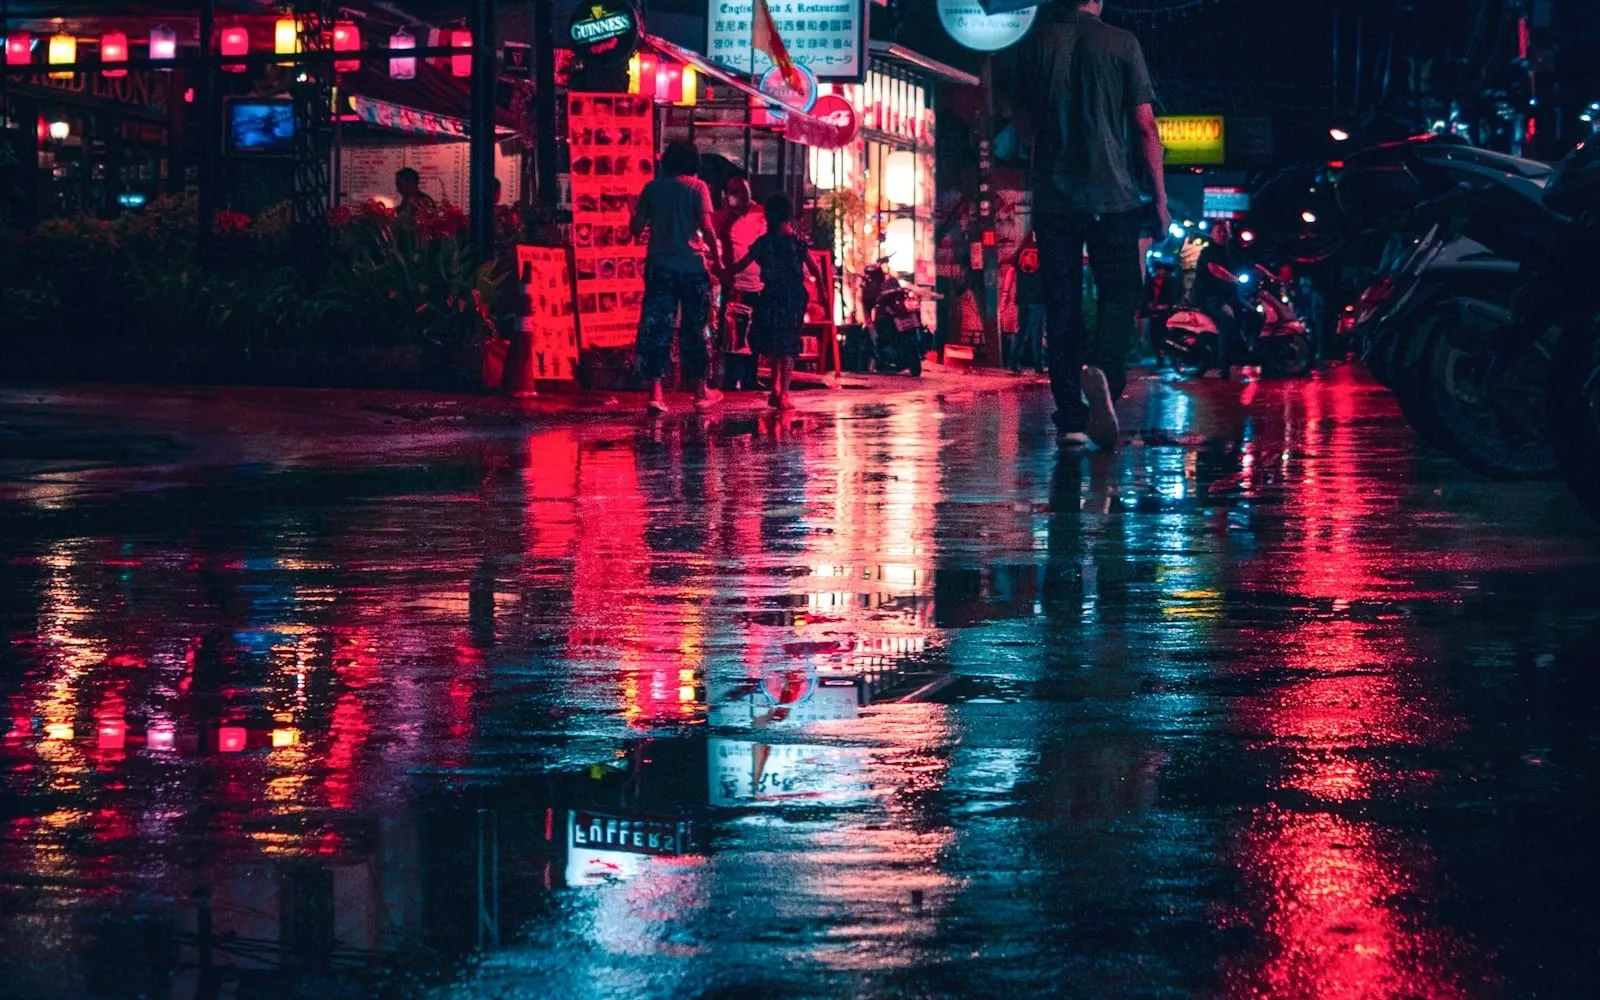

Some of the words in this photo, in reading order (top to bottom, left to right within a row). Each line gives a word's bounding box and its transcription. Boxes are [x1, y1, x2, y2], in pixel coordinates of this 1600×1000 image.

[719, 3, 752, 14] Englis
[784, 4, 793, 13] &
[797, 3, 850, 13] Restaurant
[571, 13, 631, 42] GUINNESS
